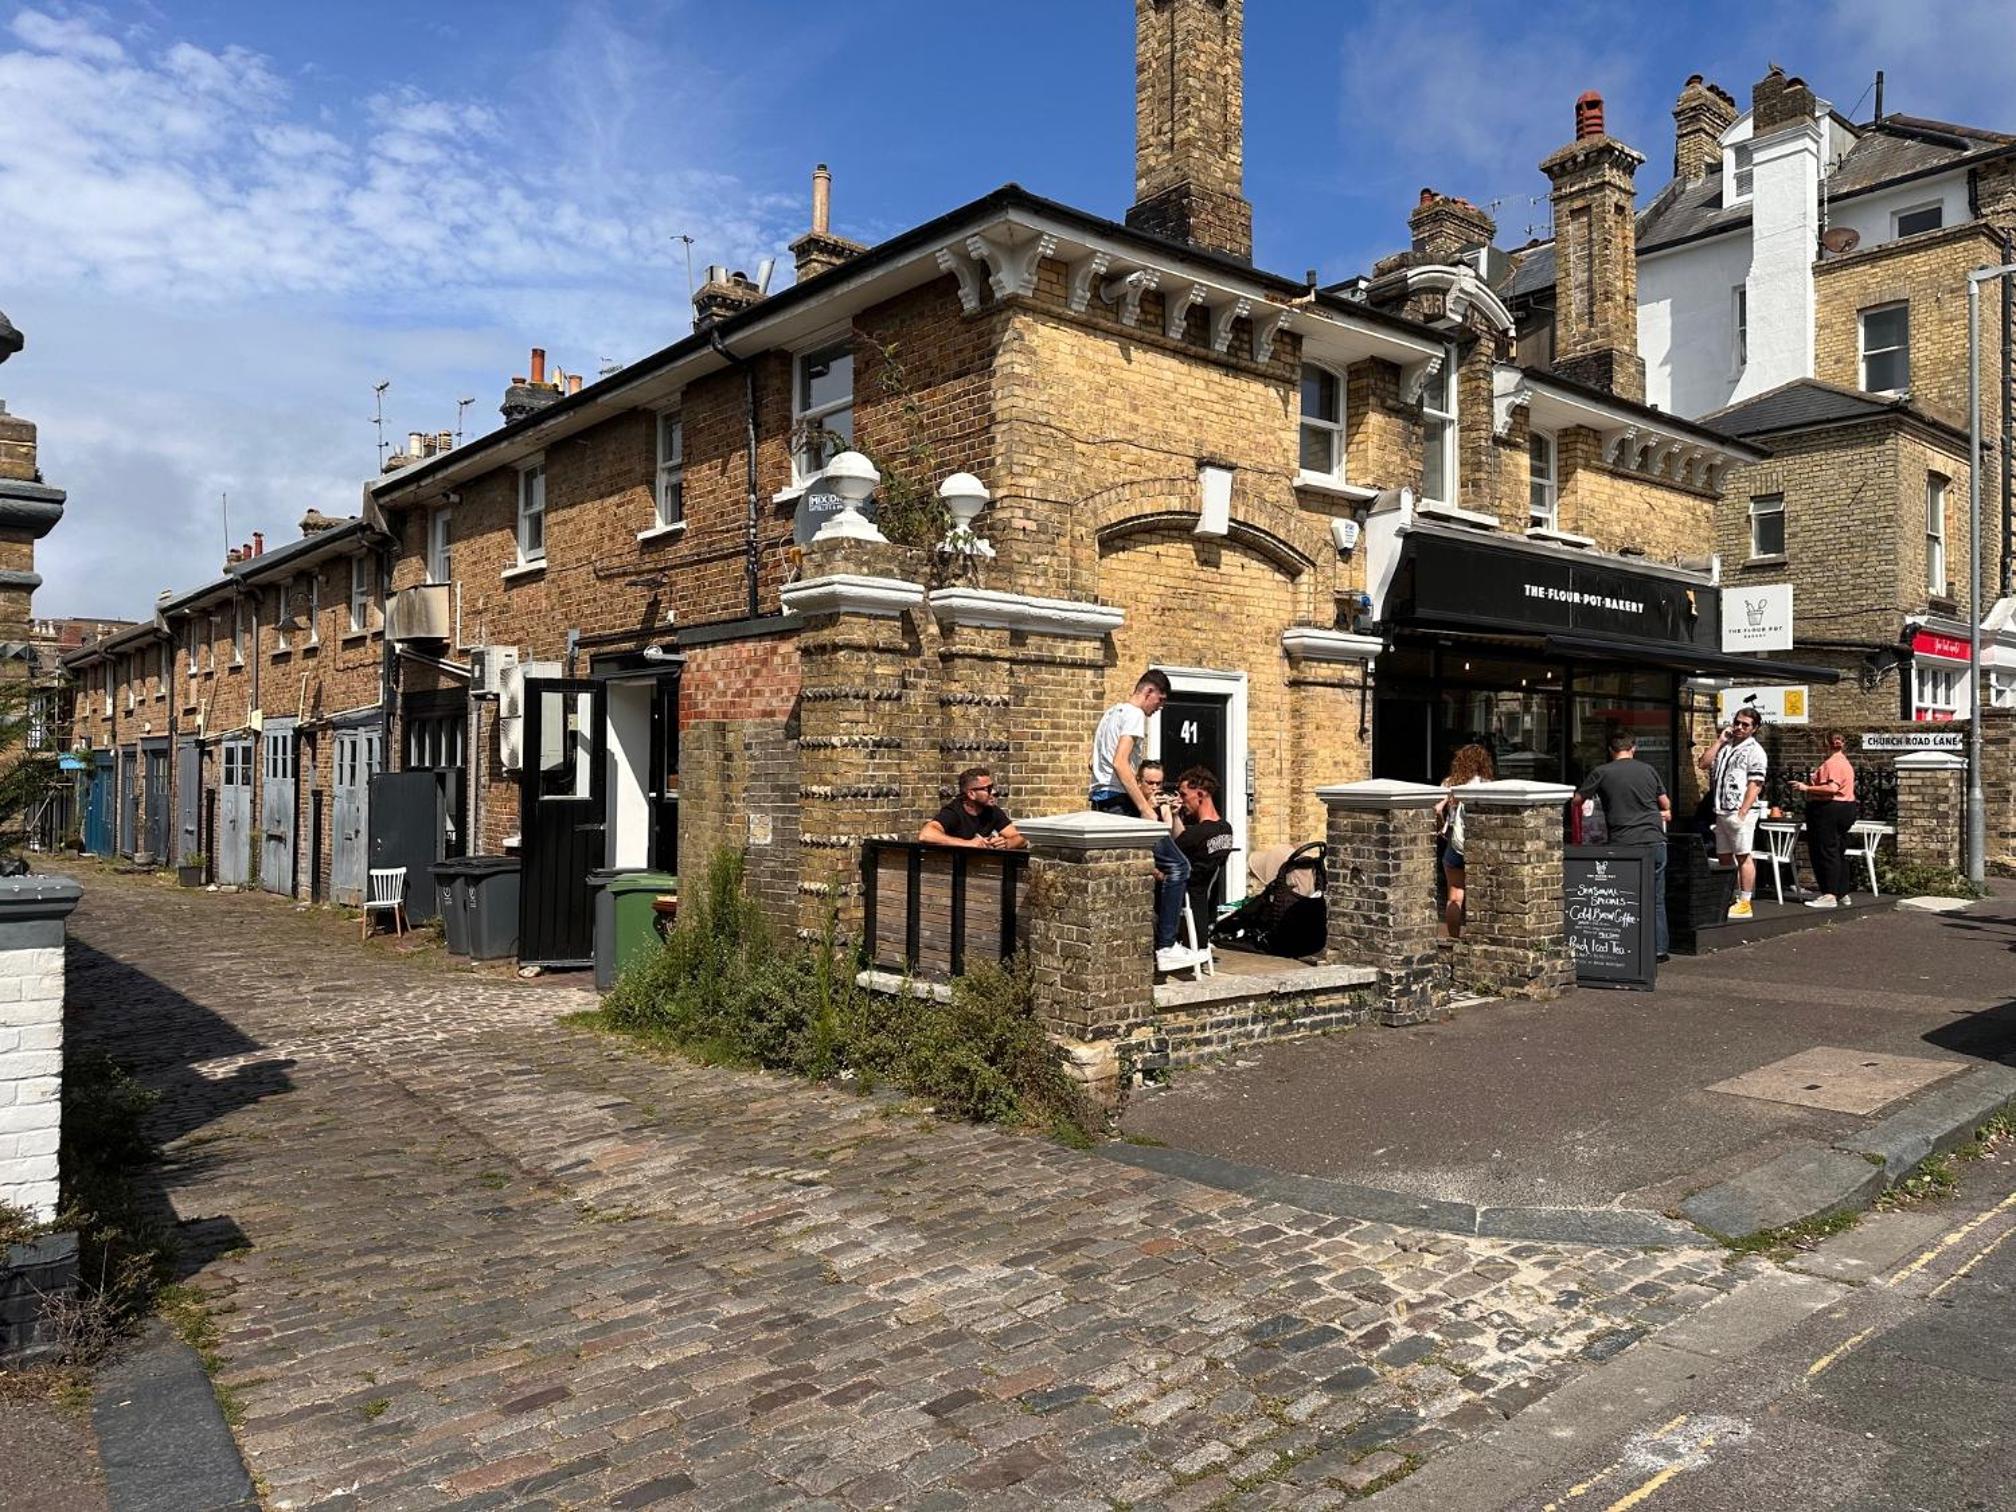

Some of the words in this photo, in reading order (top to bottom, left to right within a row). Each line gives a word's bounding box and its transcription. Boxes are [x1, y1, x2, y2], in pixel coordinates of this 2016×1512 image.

[811, 495, 828, 505] MIX
[1524, 584, 1545, 598] THE
[1548, 588, 1581, 604] FLOUR
[1583, 594, 1602, 607] POT
[1605, 598, 1644, 614] BAKERY
[1180, 720, 1198, 744] 41
[1867, 737, 1902, 745] CHURCH
[1905, 737, 1931, 745] ROAD
[1933, 737, 1958, 745] LANE
[1569, 905, 1592, 920] Cold
[1614, 908, 1636, 927] Coffee
[1592, 939, 1608, 953] Iced
